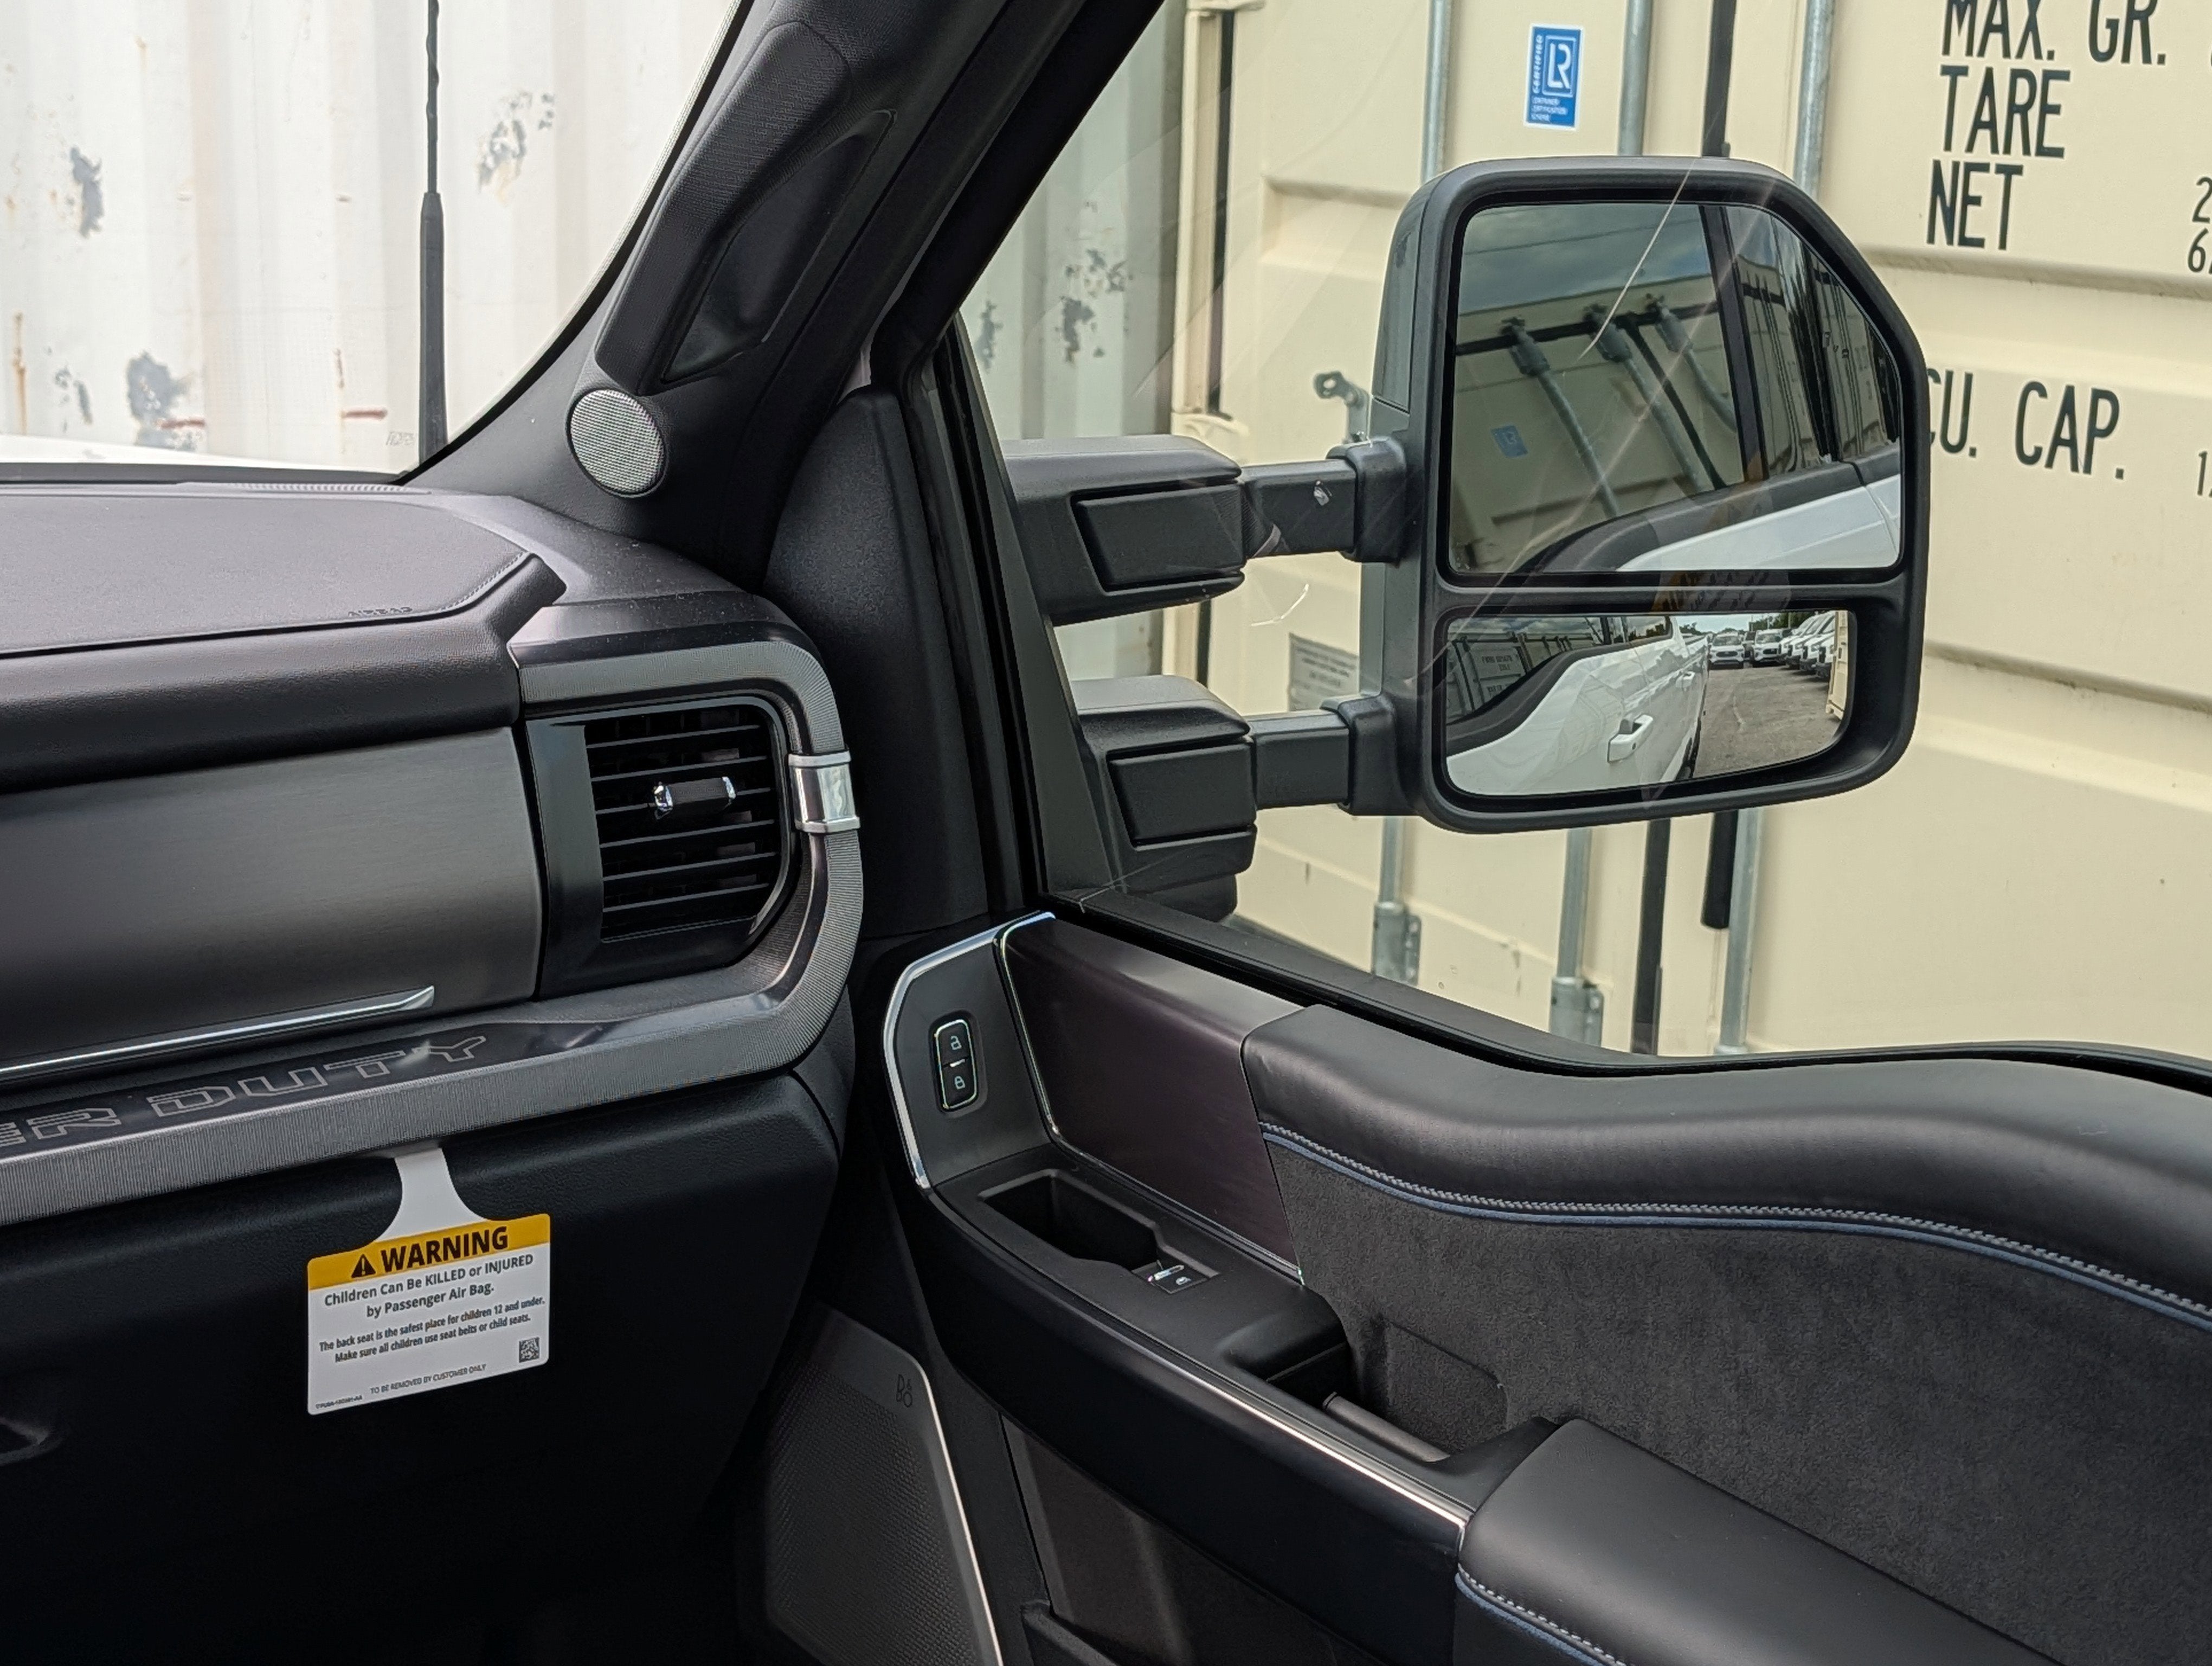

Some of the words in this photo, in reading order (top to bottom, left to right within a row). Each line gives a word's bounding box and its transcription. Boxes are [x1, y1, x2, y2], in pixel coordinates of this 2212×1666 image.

[1942, 0, 2055, 61] MAX.
[2088, 0, 2166, 65] GR.
[1940, 65, 2070, 159] TARE
[1926, 159, 2023, 251] NET
[2015, 381, 2124, 480] CAP.
[146, 1036, 486, 1118] DUTY
[381, 1226, 509, 1273] WARNING
[324, 1288, 377, 1306] Children
[380, 1283, 403, 1295] Can
[407, 1278, 422, 1290] Be
[425, 1268, 466, 1286] KILLED
[469, 1266, 482, 1277] or
[485, 1254, 533, 1274] INJURED
[366, 1305, 382, 1319] by
[384, 1292, 446, 1313] Passenger
[448, 1287, 466, 1300] Air
[470, 1283, 494, 1296] Bag.
[319, 1341, 335, 1351] The
[336, 1335, 355, 1348] back
[357, 1332, 374, 1344] seat
[376, 1330, 383, 1340] is
[384, 1328, 398, 1338] the
[400, 1322, 423, 1335] safest
[425, 1318, 446, 1332] place
[447, 1315, 459, 1325] for
[460, 1309, 492, 1322] children
[494, 1304, 503, 1315] 12
[504, 1300, 519, 1312] and
[520, 1297, 545, 1309] under.
[335, 1350, 358, 1363] Make
[359, 1347, 377, 1357] sure
[379, 1342, 389, 1354] all
[390, 1337, 423, 1351] children
[425, 1334, 438, 1343] use
[440, 1329, 456, 1340] seat
[458, 1325, 477, 1336] belts
[479, 1323, 487, 1332] or
[489, 1317, 507, 1330] child
[509, 1314, 531, 1325] seats.
